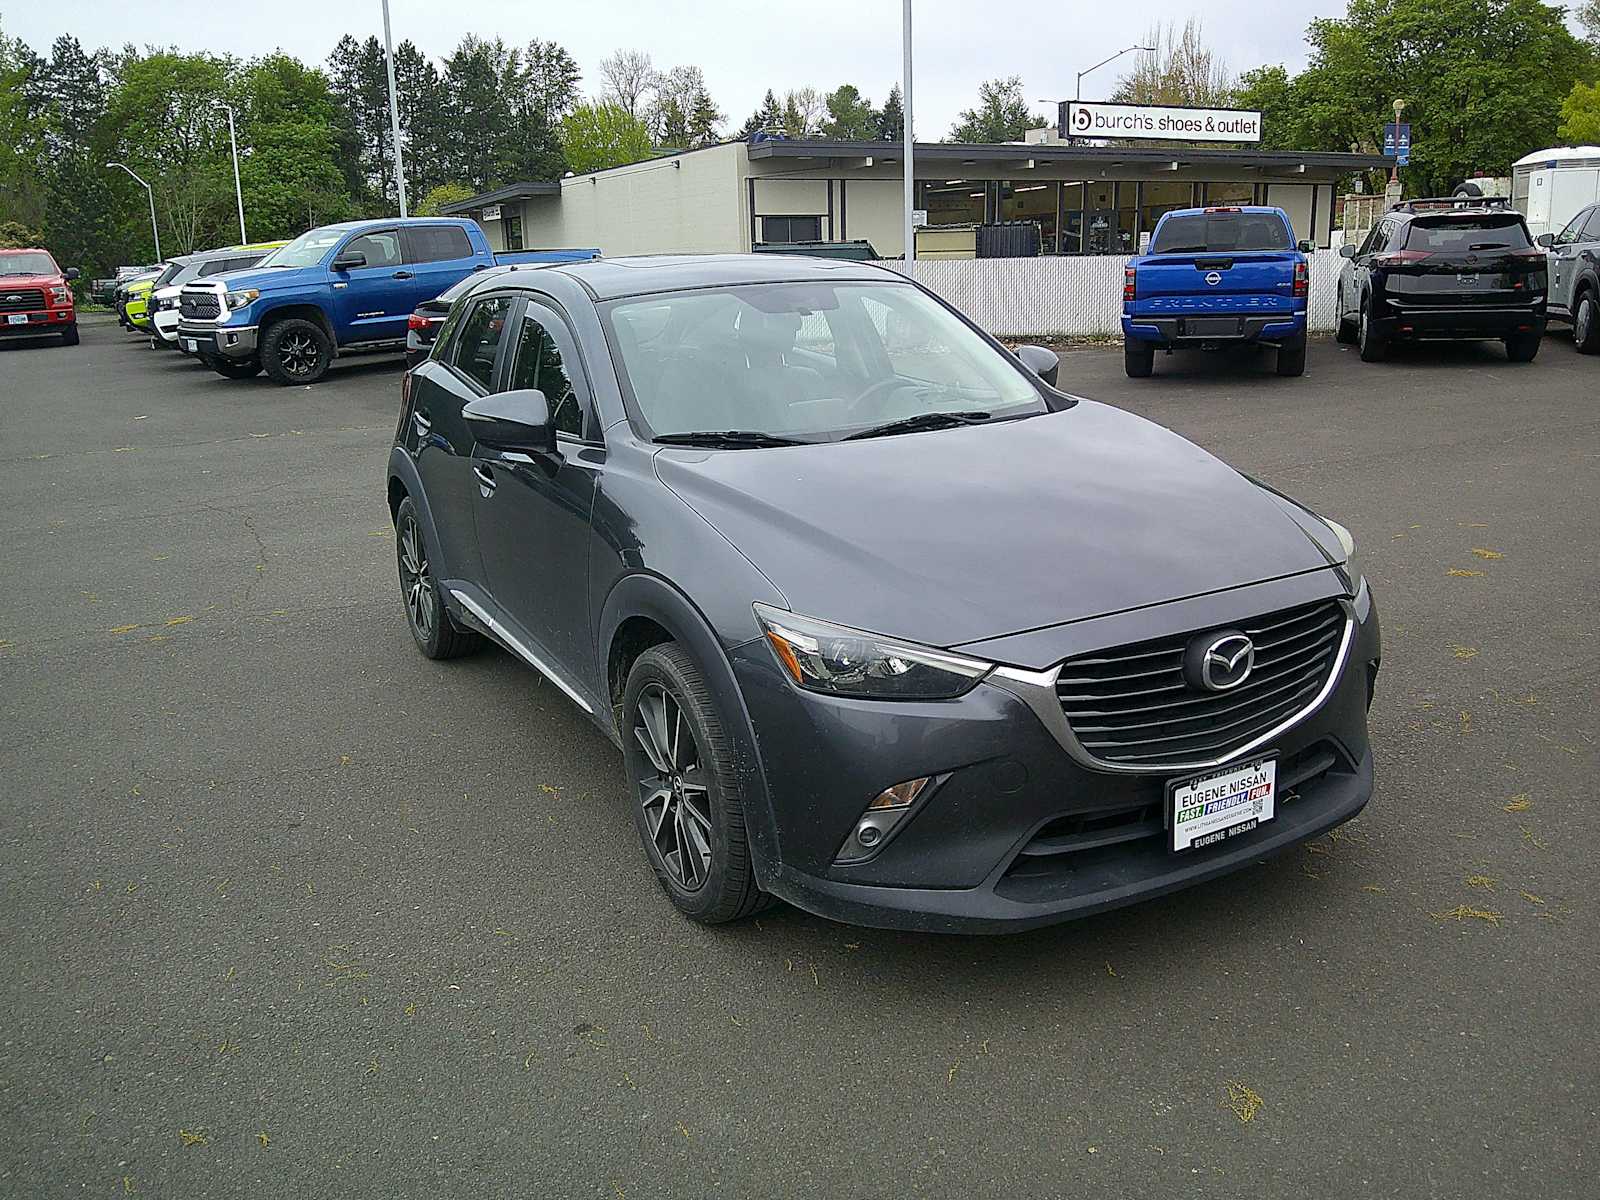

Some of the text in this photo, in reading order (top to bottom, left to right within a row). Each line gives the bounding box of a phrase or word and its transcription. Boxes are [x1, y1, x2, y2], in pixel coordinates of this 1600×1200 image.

[1095, 112, 1153, 130] burch's
[1158, 115, 1202, 132] shoes
[1205, 117, 1215, 132] &
[1218, 118, 1257, 134] outlet
[1182, 785, 1226, 808] EUGENE
[1229, 771, 1267, 793] NISSAN
[1195, 820, 1257, 848] EUGENE NISSAN
